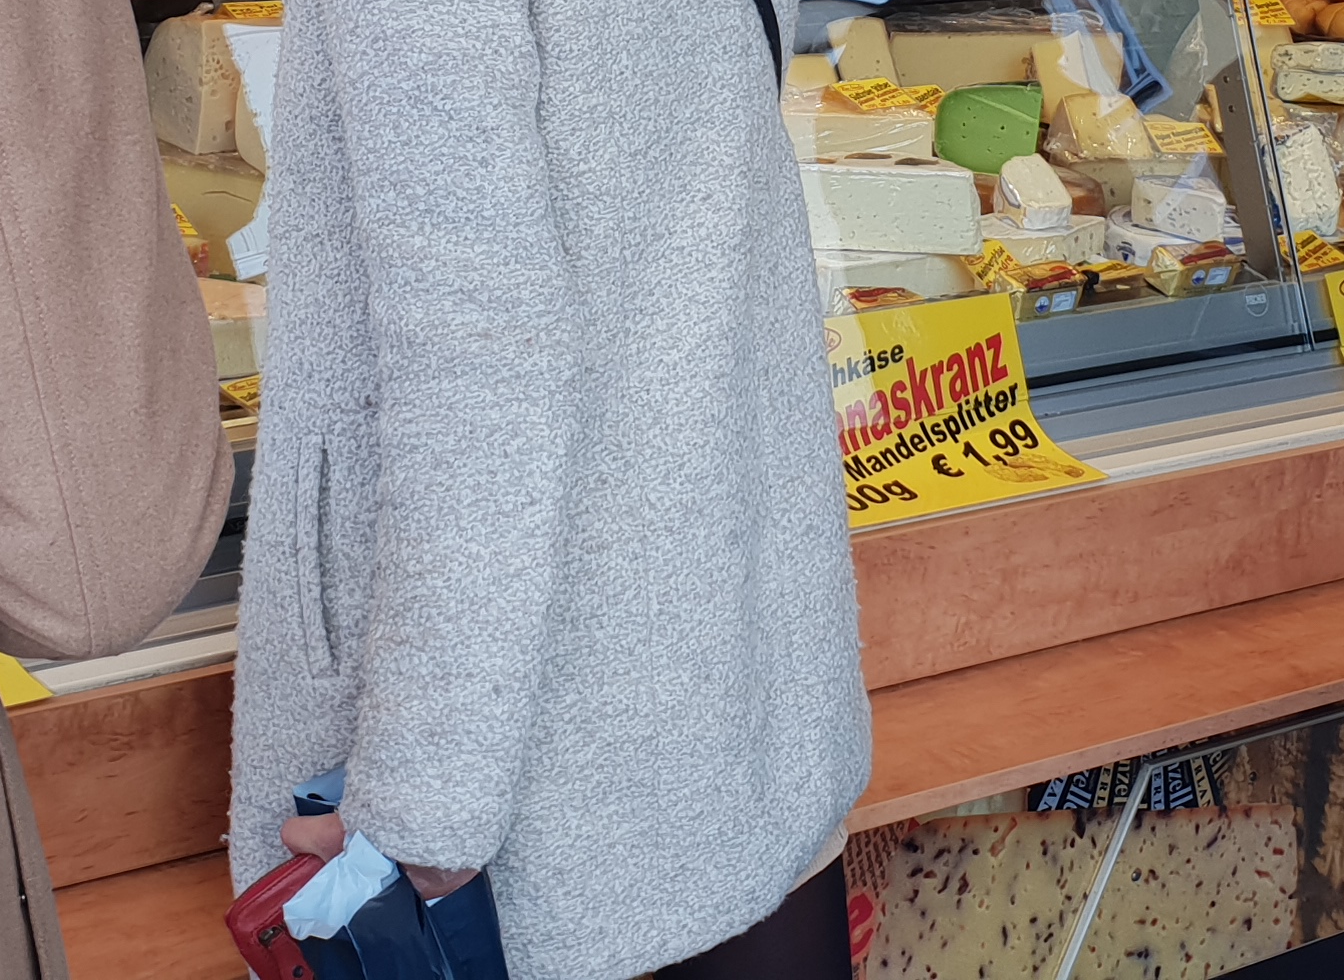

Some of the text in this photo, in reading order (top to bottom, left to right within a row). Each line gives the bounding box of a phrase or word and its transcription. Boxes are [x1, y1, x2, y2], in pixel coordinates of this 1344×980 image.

[842, 382, 1019, 483] Mandelsplitter
[931, 453, 965, 478] €
[962, 419, 1040, 467] 1,99
